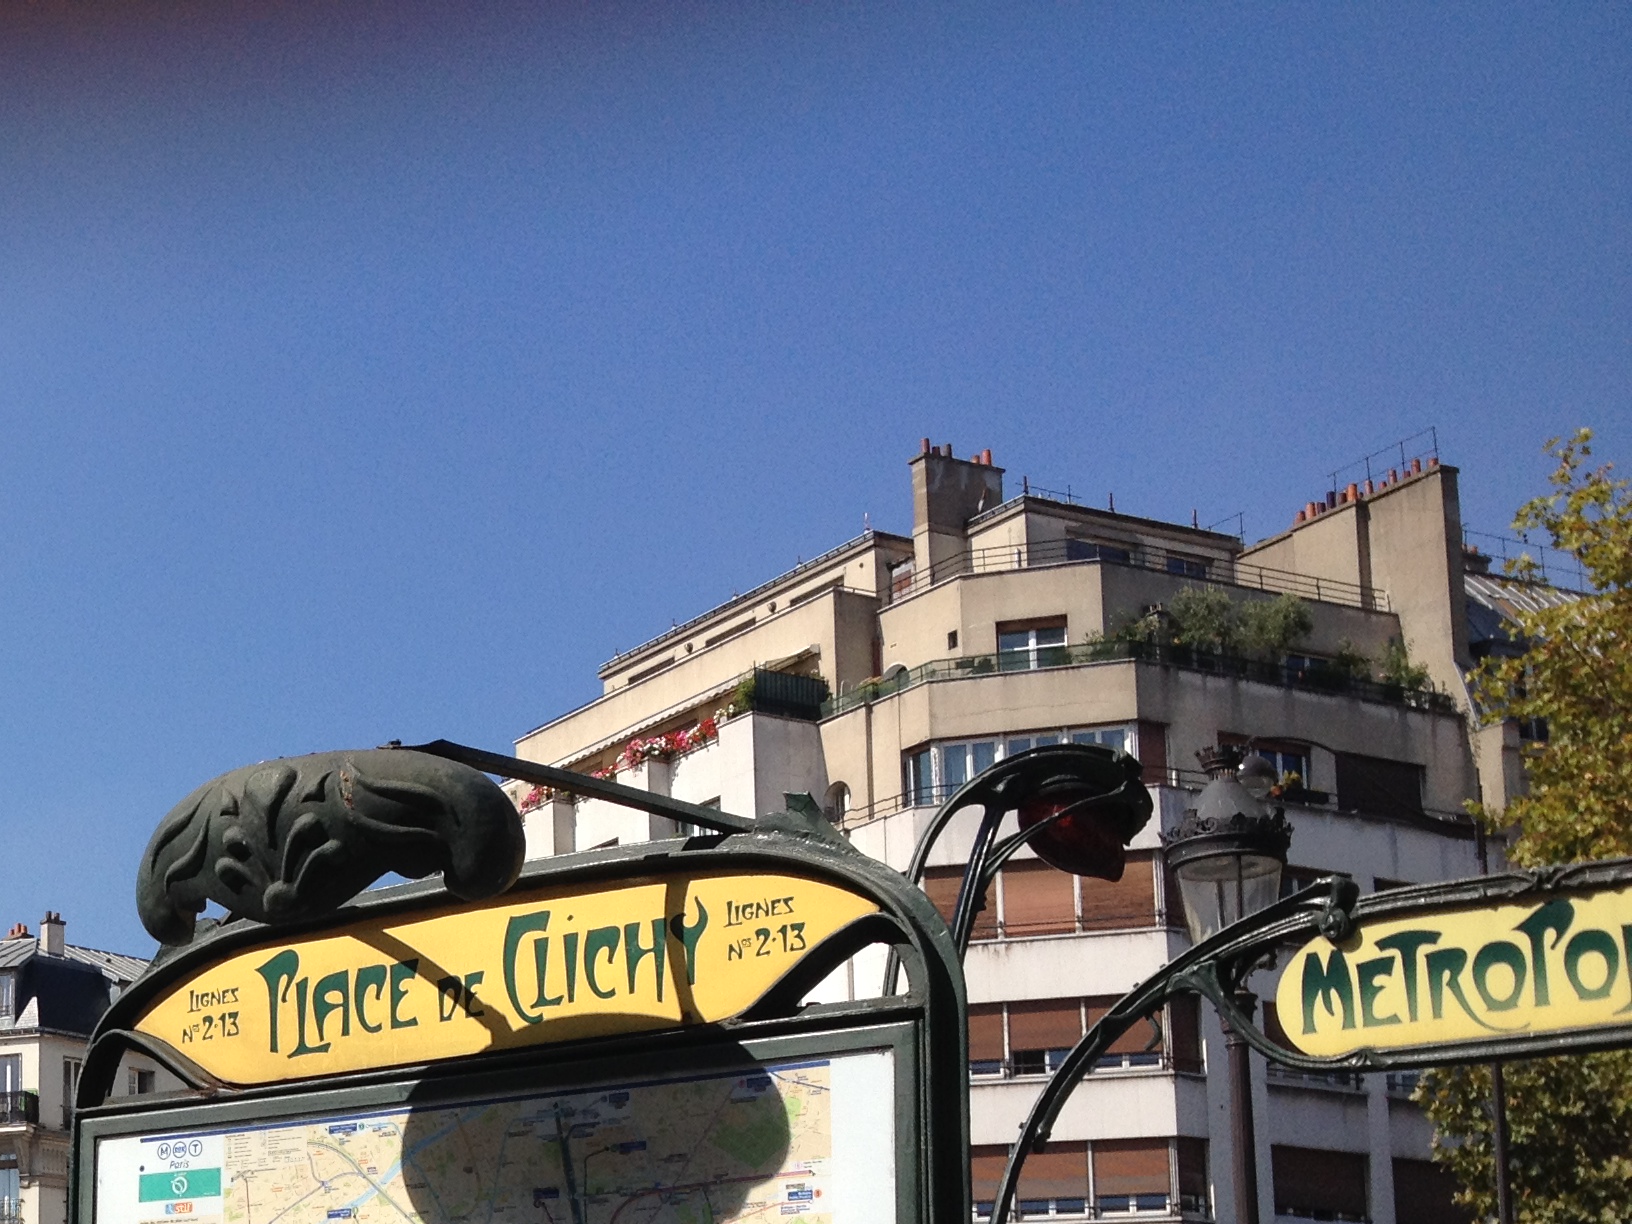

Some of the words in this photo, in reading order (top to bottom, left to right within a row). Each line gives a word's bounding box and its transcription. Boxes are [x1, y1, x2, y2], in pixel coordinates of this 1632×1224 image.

[723, 895, 796, 928] LIGNES
[254, 949, 419, 1059] PLACE
[436, 970, 484, 1022] DE
[502, 895, 708, 1025] CLICHY
[187, 987, 239, 1014] LIGNES
[169, 1160, 190, 1169] Paris
